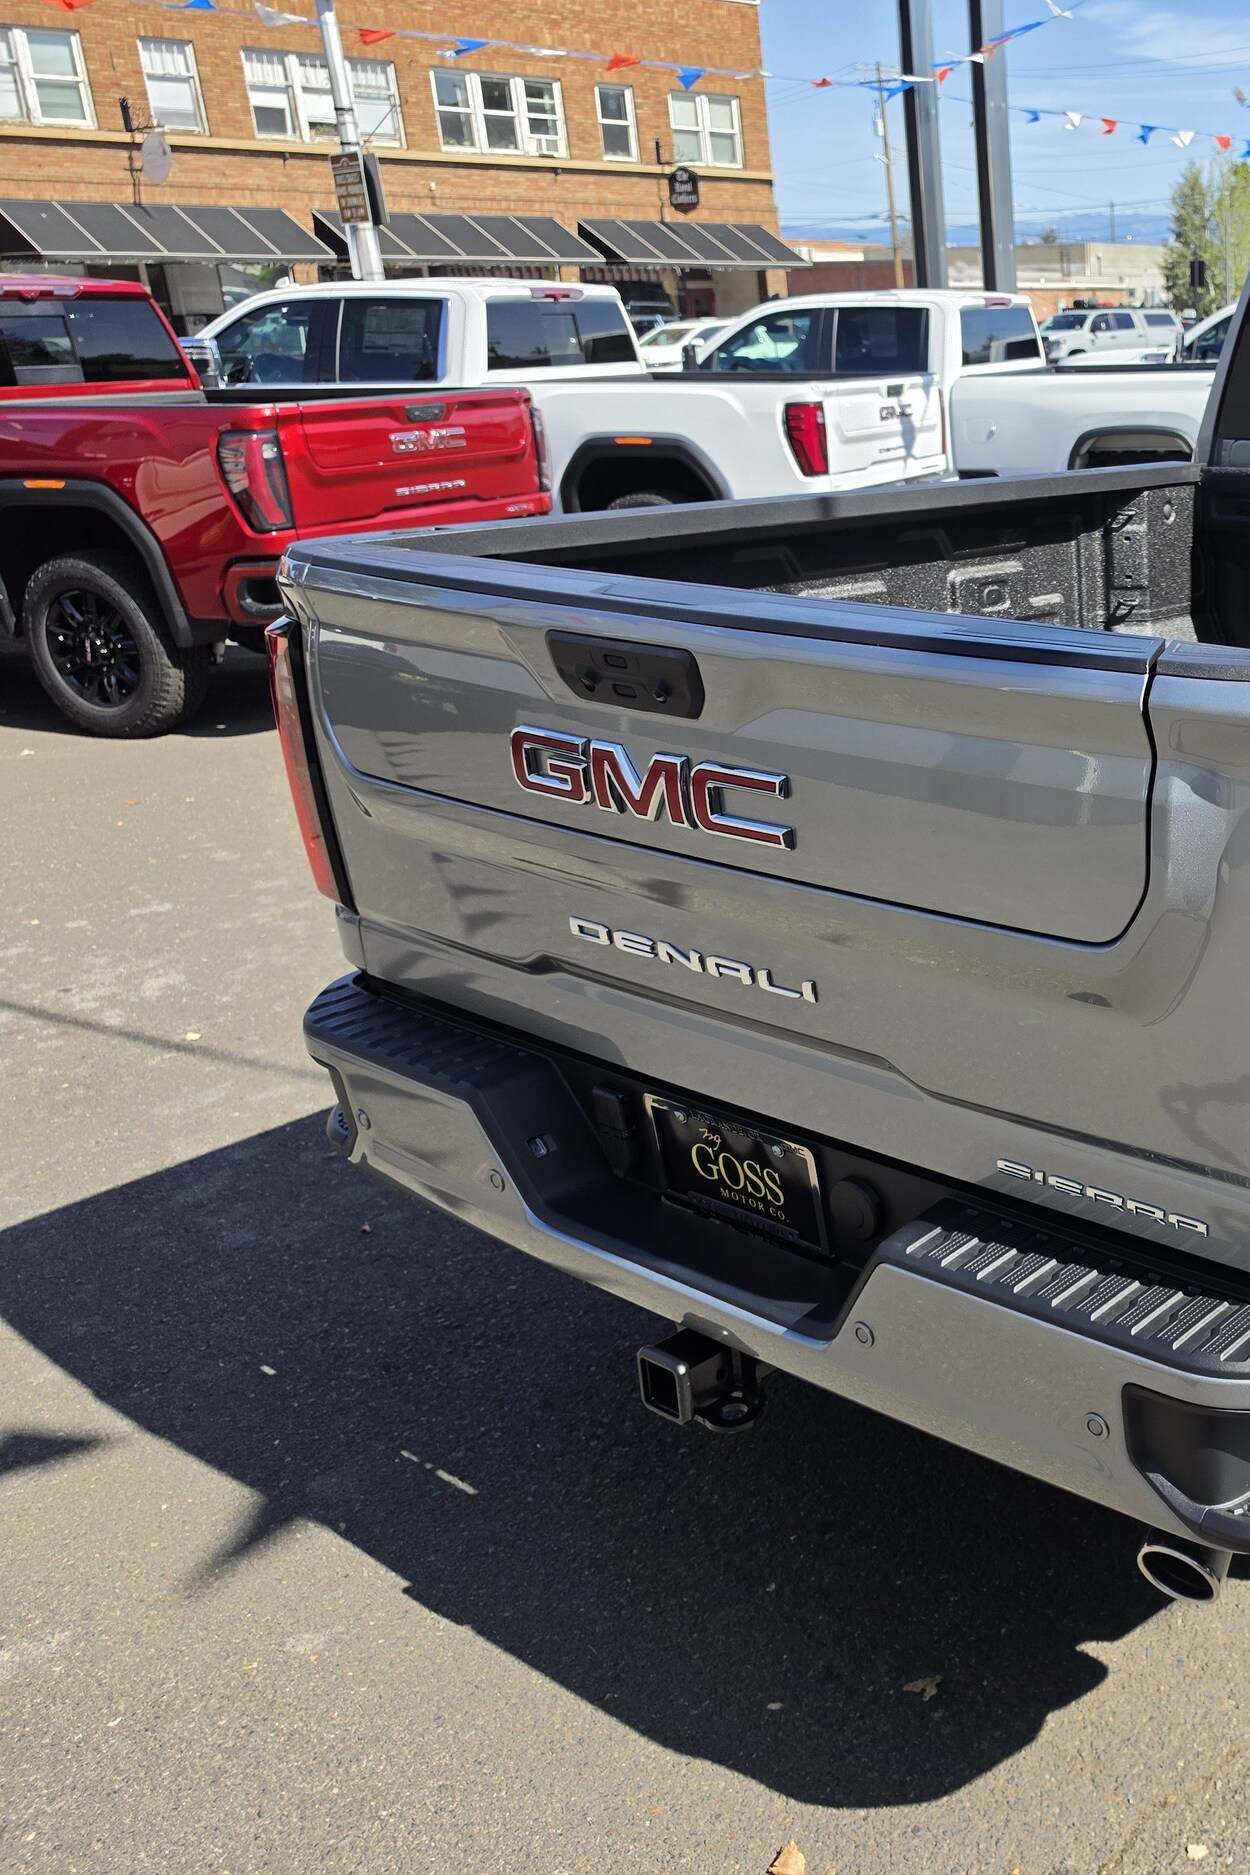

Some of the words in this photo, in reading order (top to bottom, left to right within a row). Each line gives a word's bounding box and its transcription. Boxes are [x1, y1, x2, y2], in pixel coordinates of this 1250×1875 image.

[389, 426, 467, 454] GMC
[395, 479, 466, 497] SIERRA
[510, 724, 796, 851] GMC
[569, 915, 819, 1004] DENALI
[691, 1143, 785, 1206] GOSS
[720, 1187, 766, 1212] MOTOR
[769, 1207, 790, 1223] CO.
[996, 1158, 1209, 1238] SIERRA
